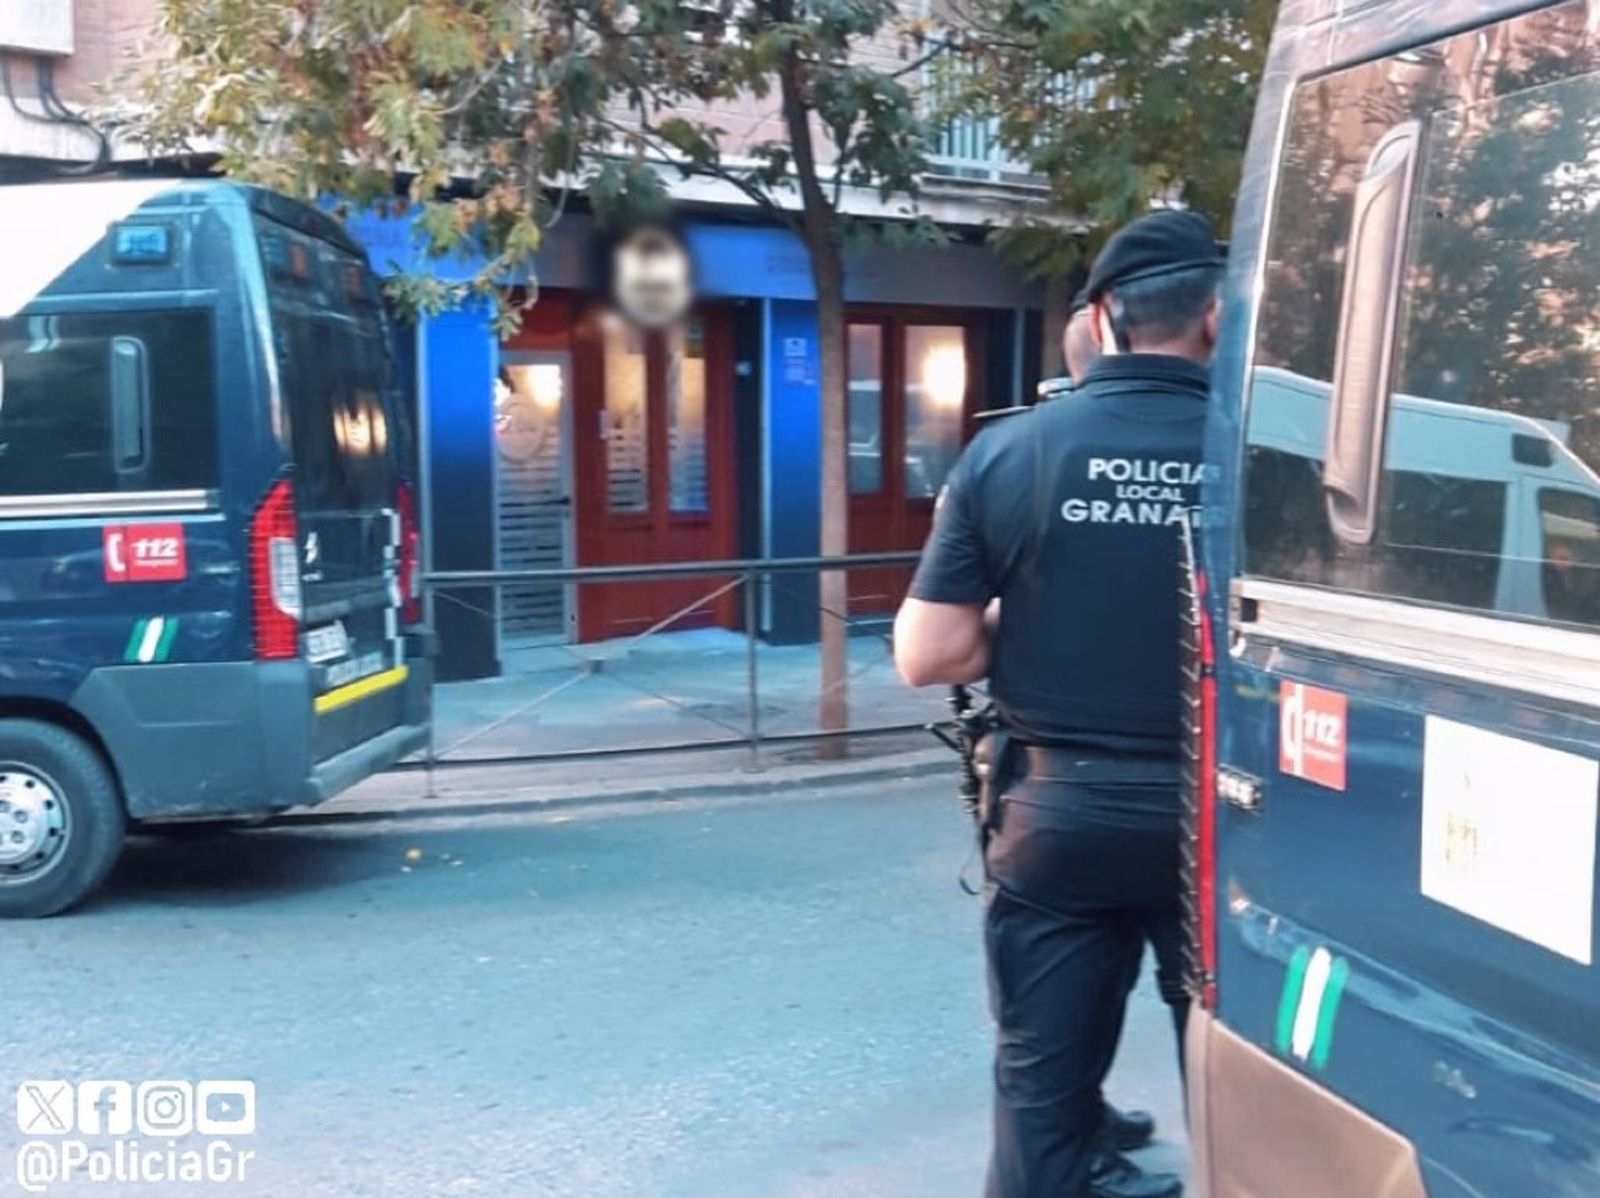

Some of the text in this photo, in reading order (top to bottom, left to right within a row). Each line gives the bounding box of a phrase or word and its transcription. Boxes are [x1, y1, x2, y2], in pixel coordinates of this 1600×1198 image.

[1088, 458, 1206, 484] POLICIA
[1115, 485, 1186, 501] LOCAL
[131, 537, 179, 559] 112
[1302, 709, 1340, 745] 112
